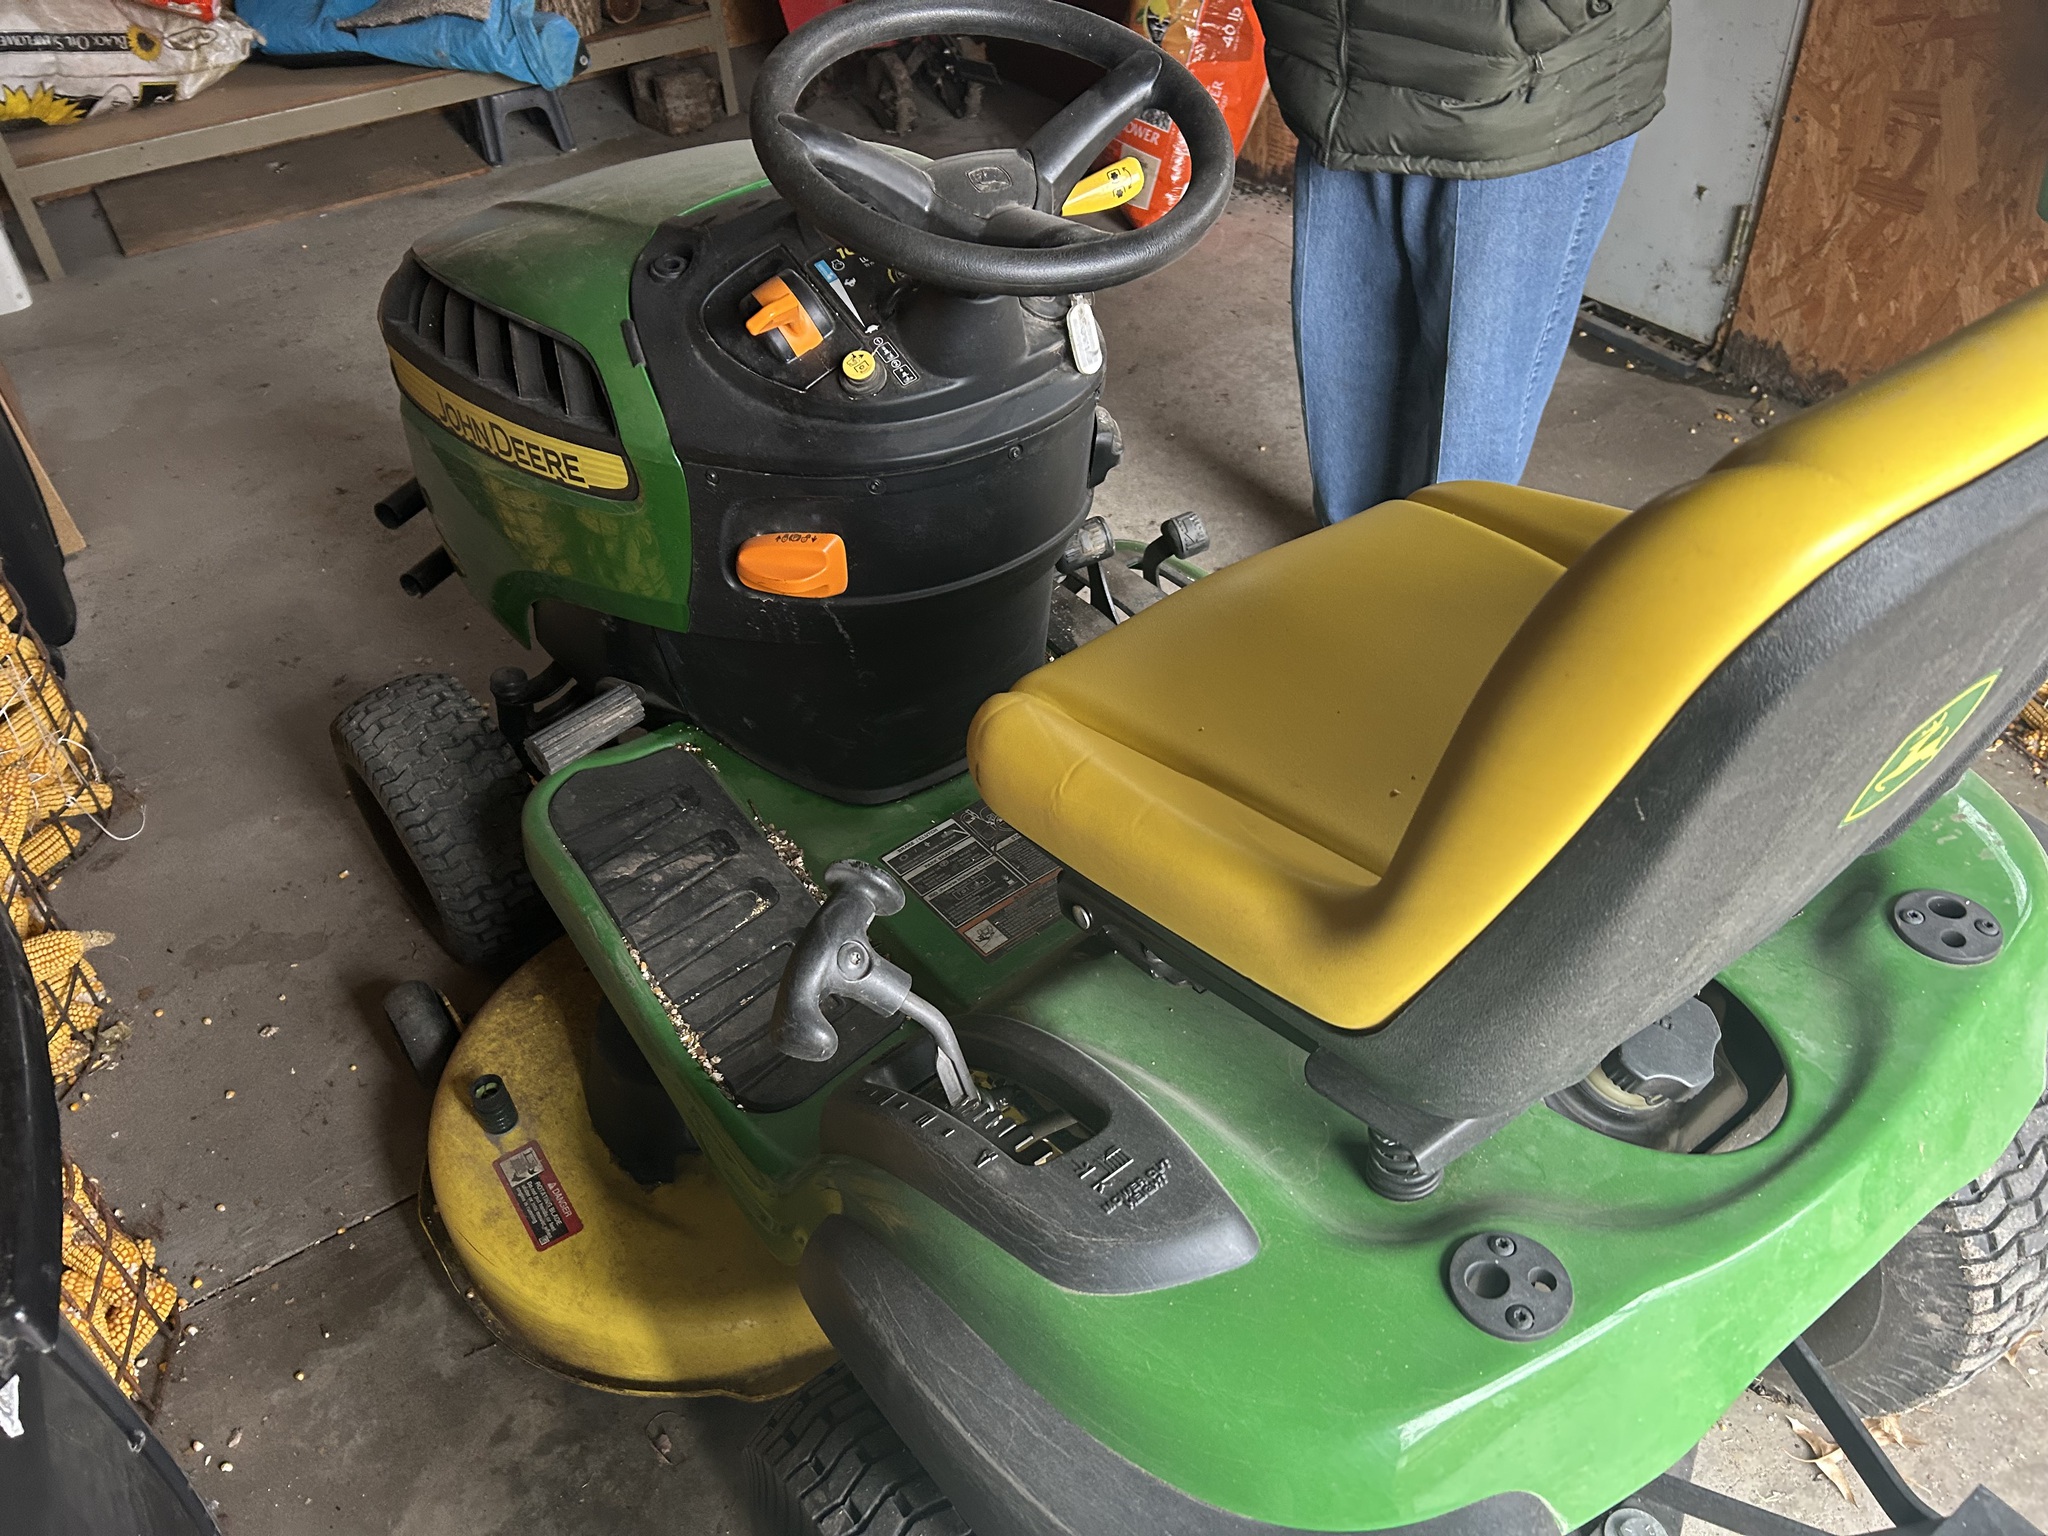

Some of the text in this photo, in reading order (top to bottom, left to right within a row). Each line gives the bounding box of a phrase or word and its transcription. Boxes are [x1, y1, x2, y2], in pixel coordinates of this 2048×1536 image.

[1226, 7, 1242, 22] lb
[1221, 24, 1237, 48] 40
[437, 391, 586, 484] JOHN DEERE
[534, 1180, 563, 1226] ROTATING BLADE
[551, 1187, 573, 1218] DANGER
